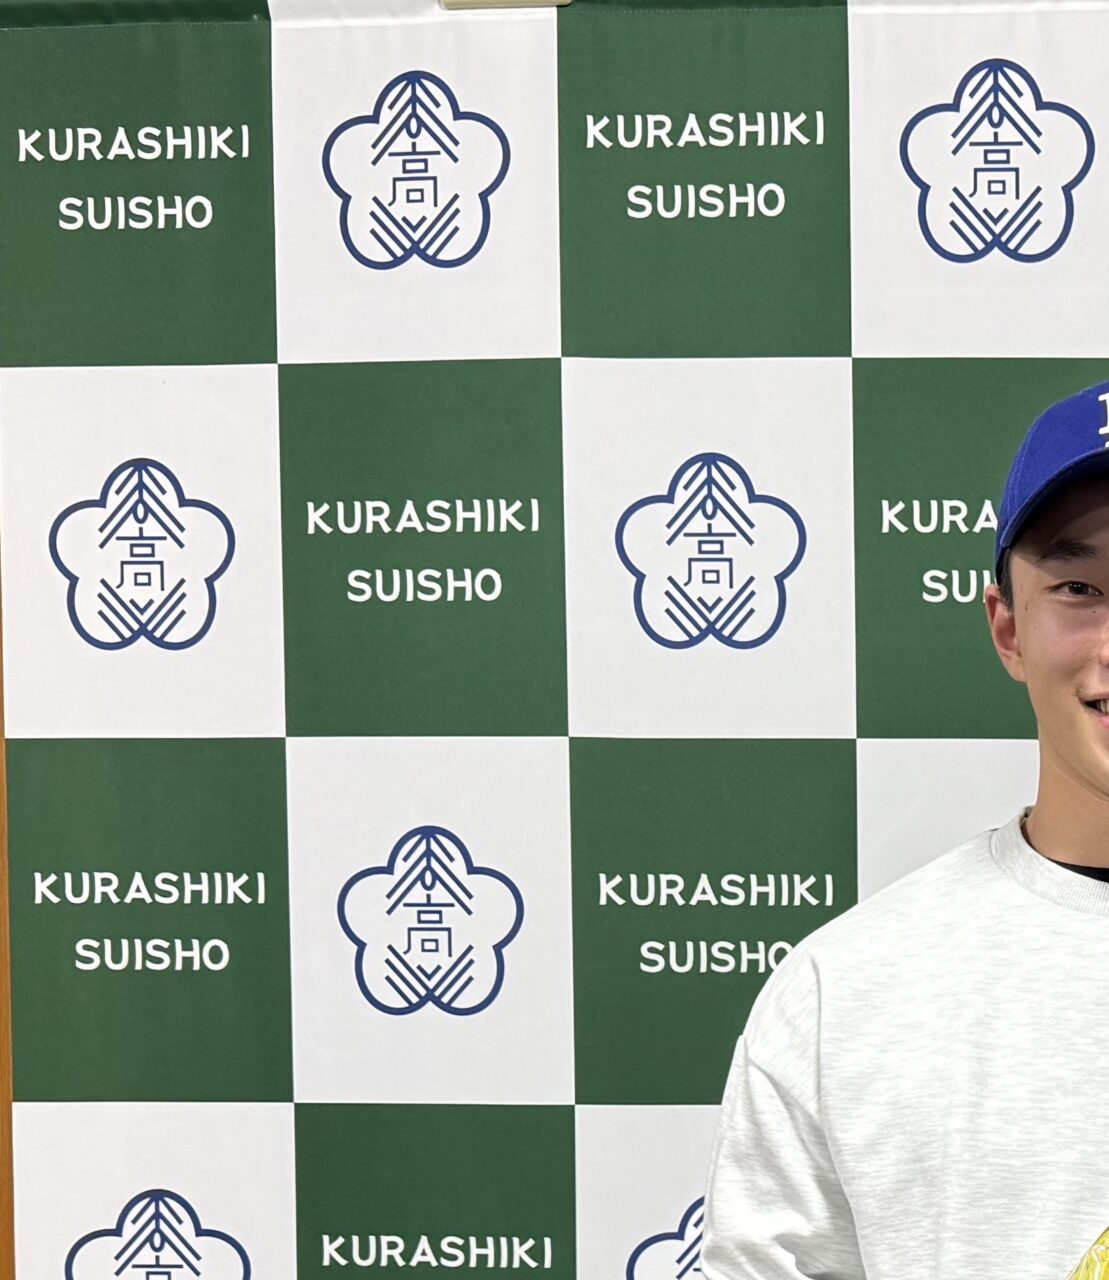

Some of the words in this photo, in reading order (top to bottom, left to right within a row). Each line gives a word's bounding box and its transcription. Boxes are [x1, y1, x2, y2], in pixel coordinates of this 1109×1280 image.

[17, 124, 250, 162] KURASHIKI
[585, 110, 825, 149] KURASHIKI
[58, 194, 213, 231] SUISHO
[626, 182, 786, 219] SUISHO
[306, 498, 540, 535] KURASHIKI
[346, 567, 503, 603] SUISHO
[33, 871, 266, 905] KURASHIKI
[598, 872, 834, 907] KURASHIKI
[75, 938, 230, 971] SUISHO
[322, 1234, 552, 1269] KURASHIKI
